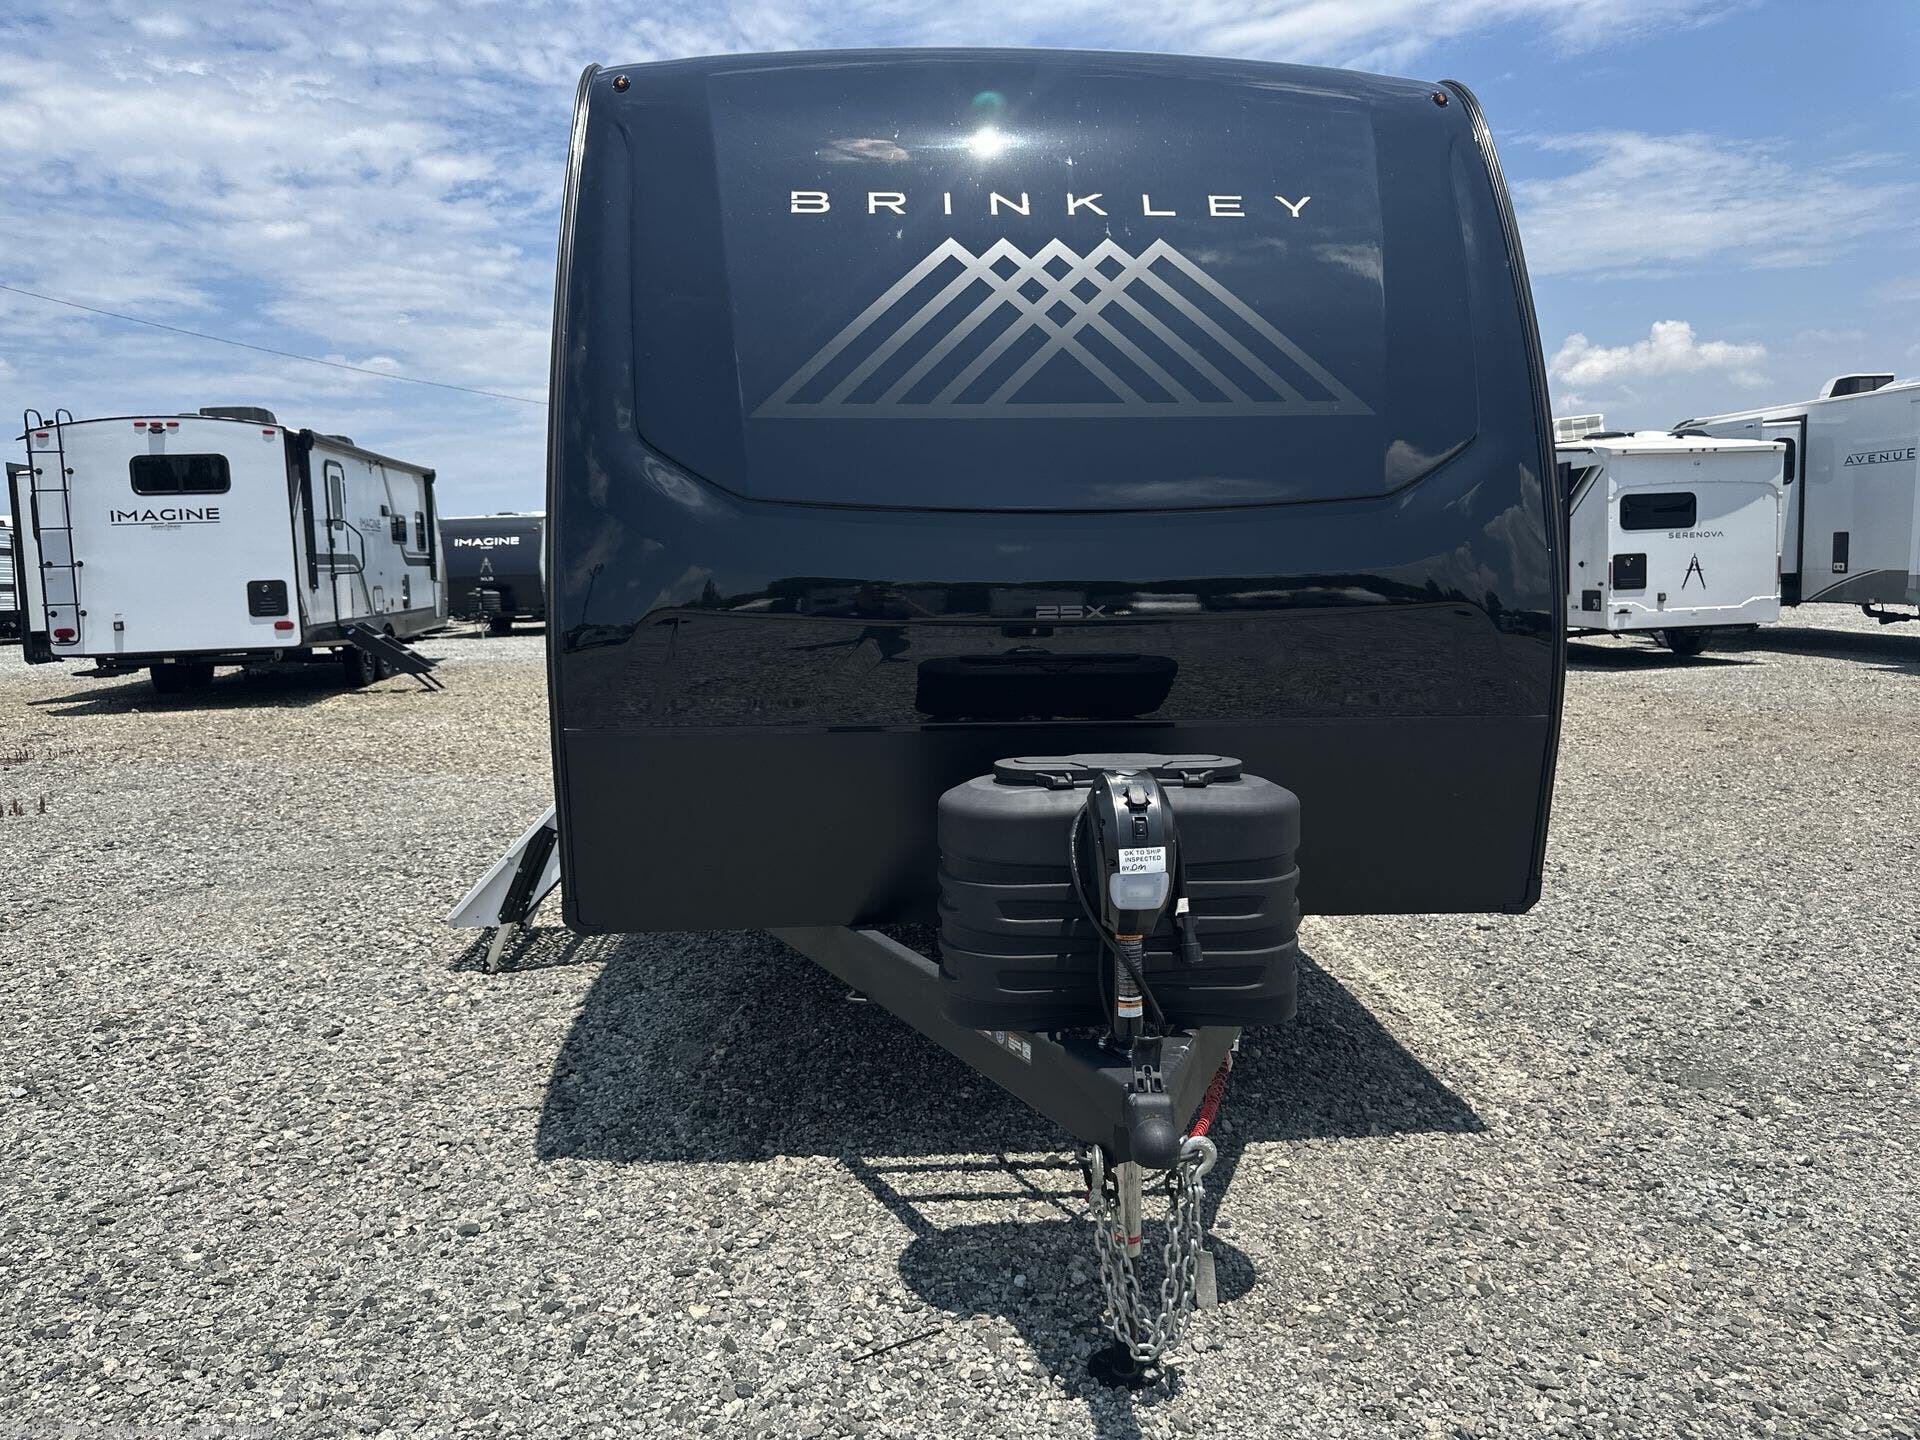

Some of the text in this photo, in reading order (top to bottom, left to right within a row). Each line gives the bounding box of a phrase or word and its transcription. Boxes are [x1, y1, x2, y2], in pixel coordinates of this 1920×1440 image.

[790, 190, 1311, 218] BRINKLEY
[1844, 448, 1916, 465] AVENUE
[110, 507, 220, 523] IMAGINE
[454, 536, 520, 547] IMAGINE
[1668, 531, 1724, 539] SERENOVA
[1036, 605, 1106, 620] 25X
